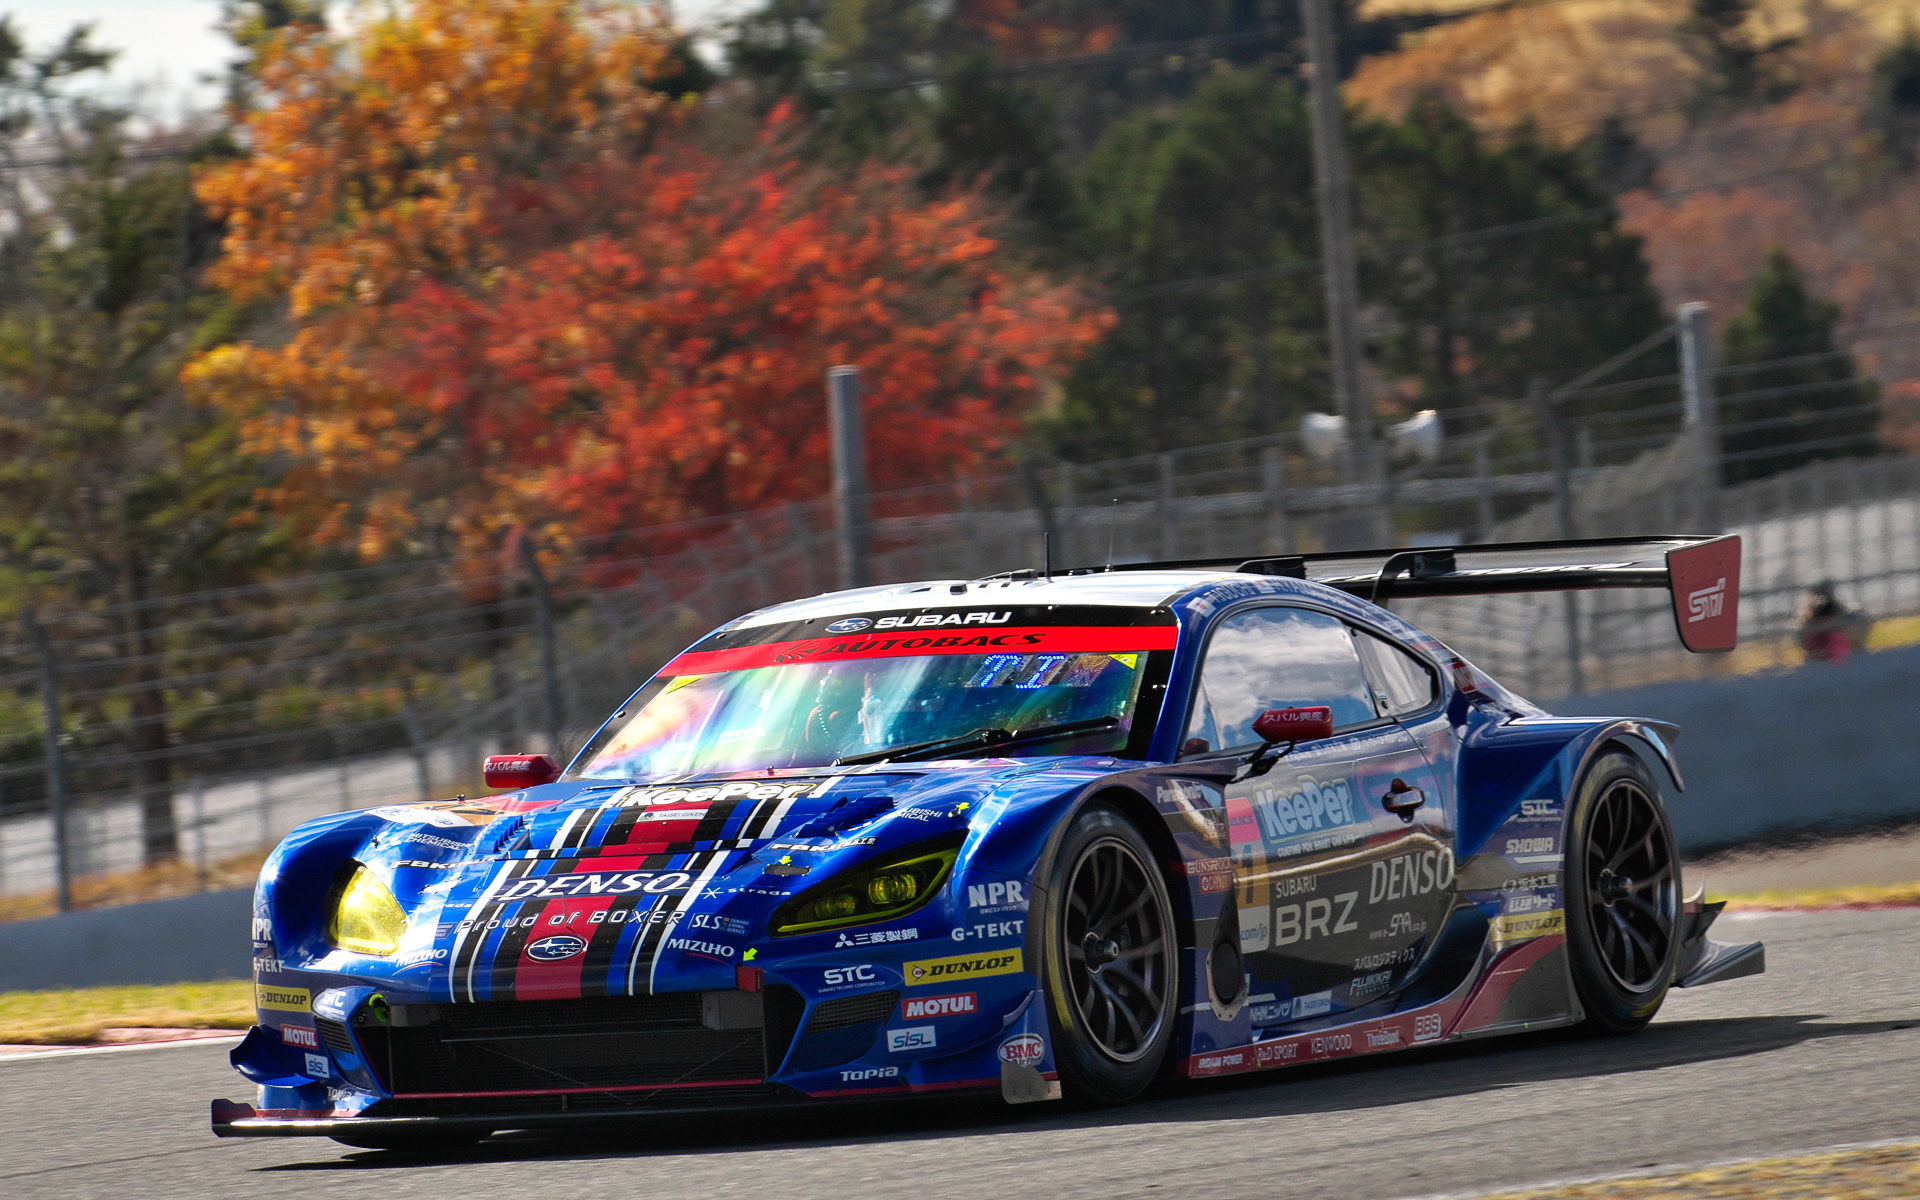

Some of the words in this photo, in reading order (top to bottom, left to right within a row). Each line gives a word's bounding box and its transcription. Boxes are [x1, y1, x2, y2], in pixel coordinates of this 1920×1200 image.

[873, 611, 1013, 630] SUBARU
[820, 633, 1045, 655] AUTOBACS
[623, 782, 809, 807] KeePer
[1256, 778, 1351, 838] KeePer
[1521, 799, 1554, 815] STC
[1505, 837, 1554, 854] SHOWA
[496, 872, 691, 901] DENSO
[1368, 848, 1453, 904] DENSO
[728, 887, 791, 897] strada
[968, 880, 1024, 908] NPR
[1275, 875, 1317, 899] SUBARU
[455, 913, 540, 934] Proud
[548, 910, 581, 927] of
[587, 908, 688, 926] BOXER
[691, 914, 723, 930] SLS
[1275, 890, 1359, 946] BRZ
[1503, 916, 1562, 934] DUNLOP
[855, 927, 919, 946] 三菱製鋼
[951, 920, 1024, 942] G-TEKT
[397, 948, 449, 968] MIZUHO
[668, 938, 735, 957] MIZUHO
[824, 964, 876, 985] STC
[928, 955, 1015, 977] DUNLOP
[266, 993, 308, 1006] DUNLOP
[906, 996, 975, 1018] MOTUL
[283, 1027, 318, 1047] MOTUL
[1414, 1013, 1442, 1041] BBS
[1004, 1042, 1041, 1060] BMC
[1273, 1043, 1299, 1060] SPORT
[1310, 1034, 1352, 1055] KENWOOD
[1222, 1054, 1244, 1067] POWER
